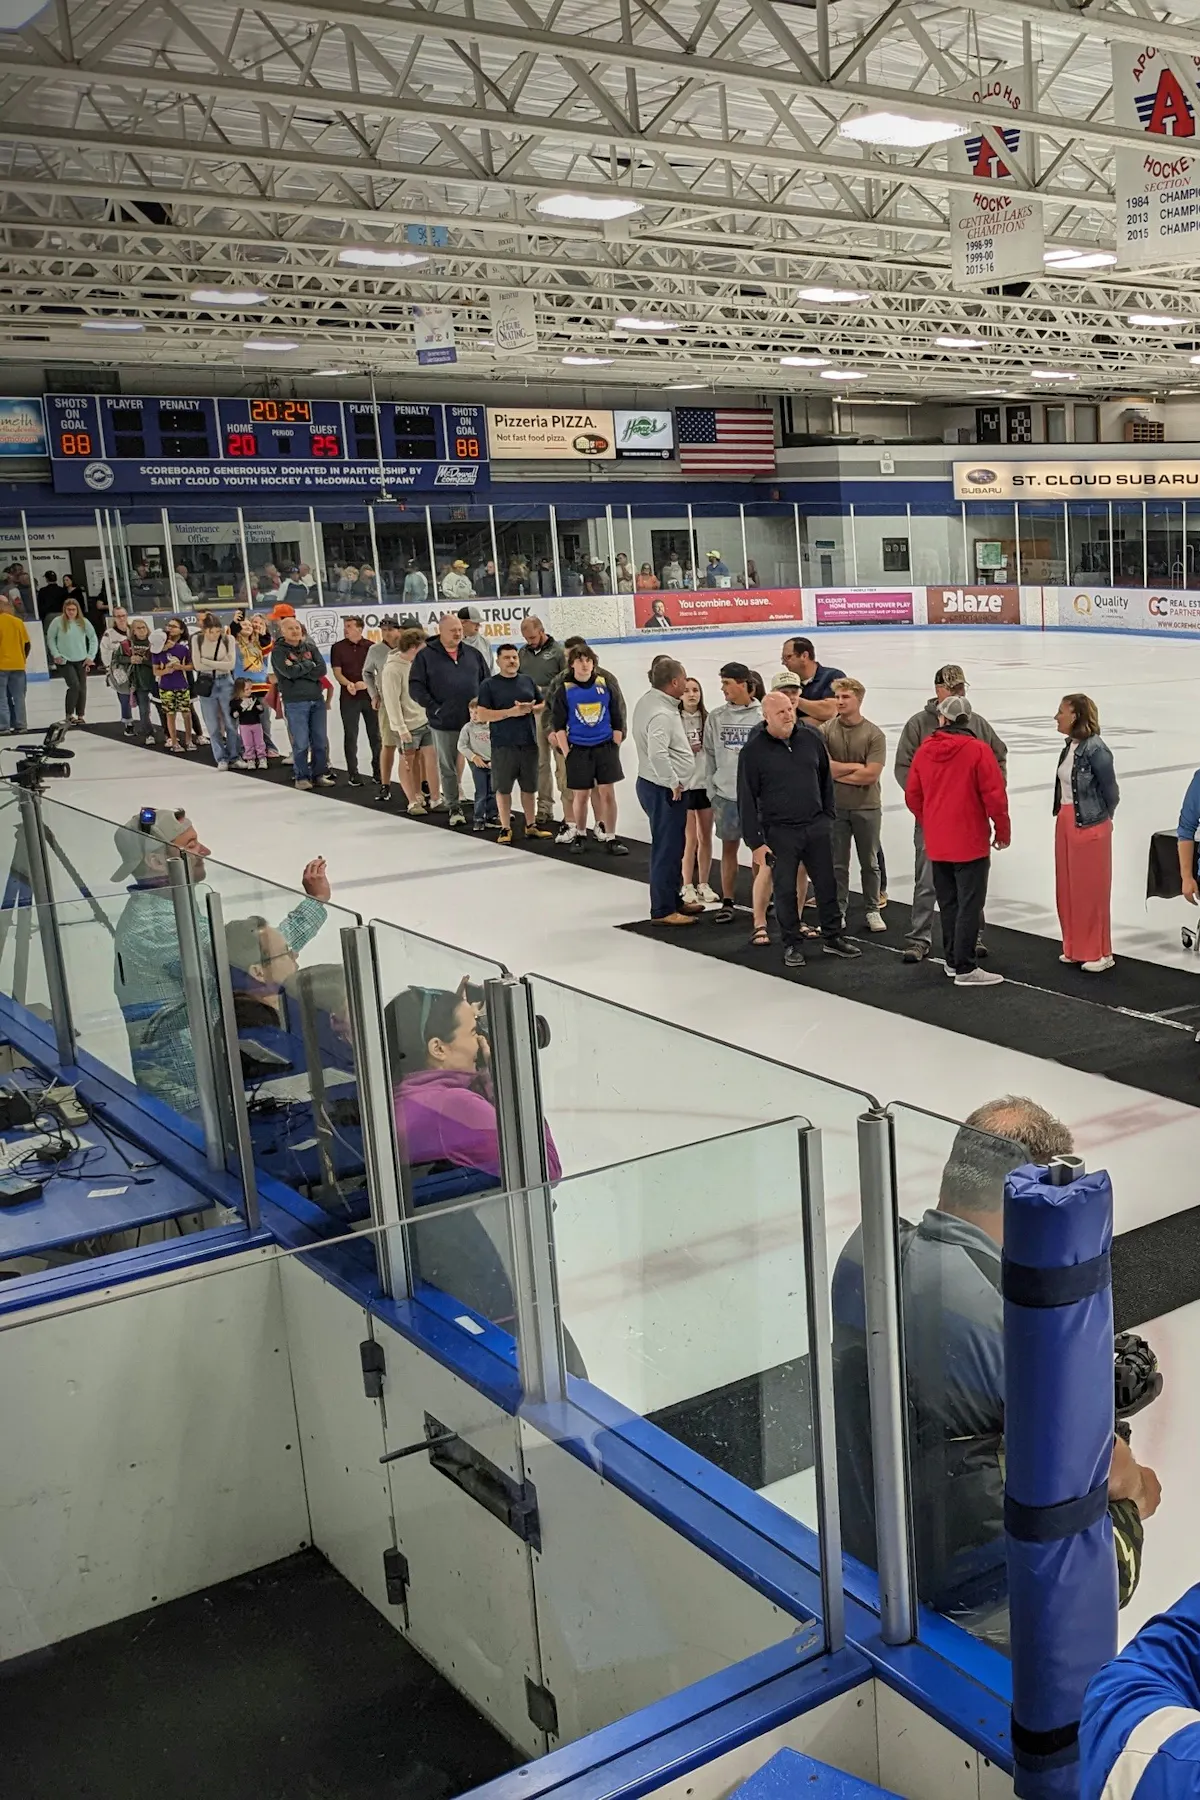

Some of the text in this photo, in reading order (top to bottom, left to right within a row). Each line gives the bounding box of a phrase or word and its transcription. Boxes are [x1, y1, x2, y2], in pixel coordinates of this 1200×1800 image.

[1144, 177, 1192, 193] SECTION
[1126, 196, 1150, 209] 1984
[958, 204, 1033, 230] CENTRAL LAKES
[1127, 213, 1149, 226] 2013
[967, 219, 1026, 240] CHAMPIONS
[1128, 229, 1149, 241] 2015
[966, 239, 994, 252] 1998-99
[966, 251, 994, 264] 1999-00
[966, 264, 994, 276] 2015-16
[55, 398, 88, 409] SHOTS
[107, 400, 200, 410] PLAYER PENALTY
[66, 410, 80, 419] ON
[252, 401, 310, 420] 20:24
[350, 405, 430, 415] PLAYER PENALTY
[452, 408, 478, 416] SHOTS
[61, 420, 87, 430] GOAL
[460, 417, 472, 426] ON
[494, 414, 597, 428] Pizzeria PIZZA.
[227, 424, 253, 433] HOME
[310, 425, 337, 434] GUEST
[456, 427, 477, 435] GOAL
[62, 434, 91, 454] 88
[496, 434, 567, 443] Not fast food pizza.
[228, 436, 339, 456] 20 25
[456, 439, 478, 456] 88
[140, 466, 210, 475] SCOREBOARD
[214, 467, 277, 475] GENEROUSLY
[343, 467, 406, 475] PARTNERSHIP
[410, 467, 422, 475] BY
[438, 467, 478, 478] McDowall
[151, 477, 414, 485] SAINT CLOUD YOUTH HOCKEY & McDOWALL COMPANY
[442, 476, 475, 486] company
[1012, 474, 1198, 486] ST. CLOUD SUBARU
[176, 524, 220, 532] Maintenance
[188, 535, 209, 543] Office
[679, 597, 772, 608] You combine. You save.
[943, 590, 1002, 612] Blaze
[1094, 595, 1128, 610] Quality
[1170, 600, 1186, 608] REAL
[482, 607, 531, 622] TRUCK
